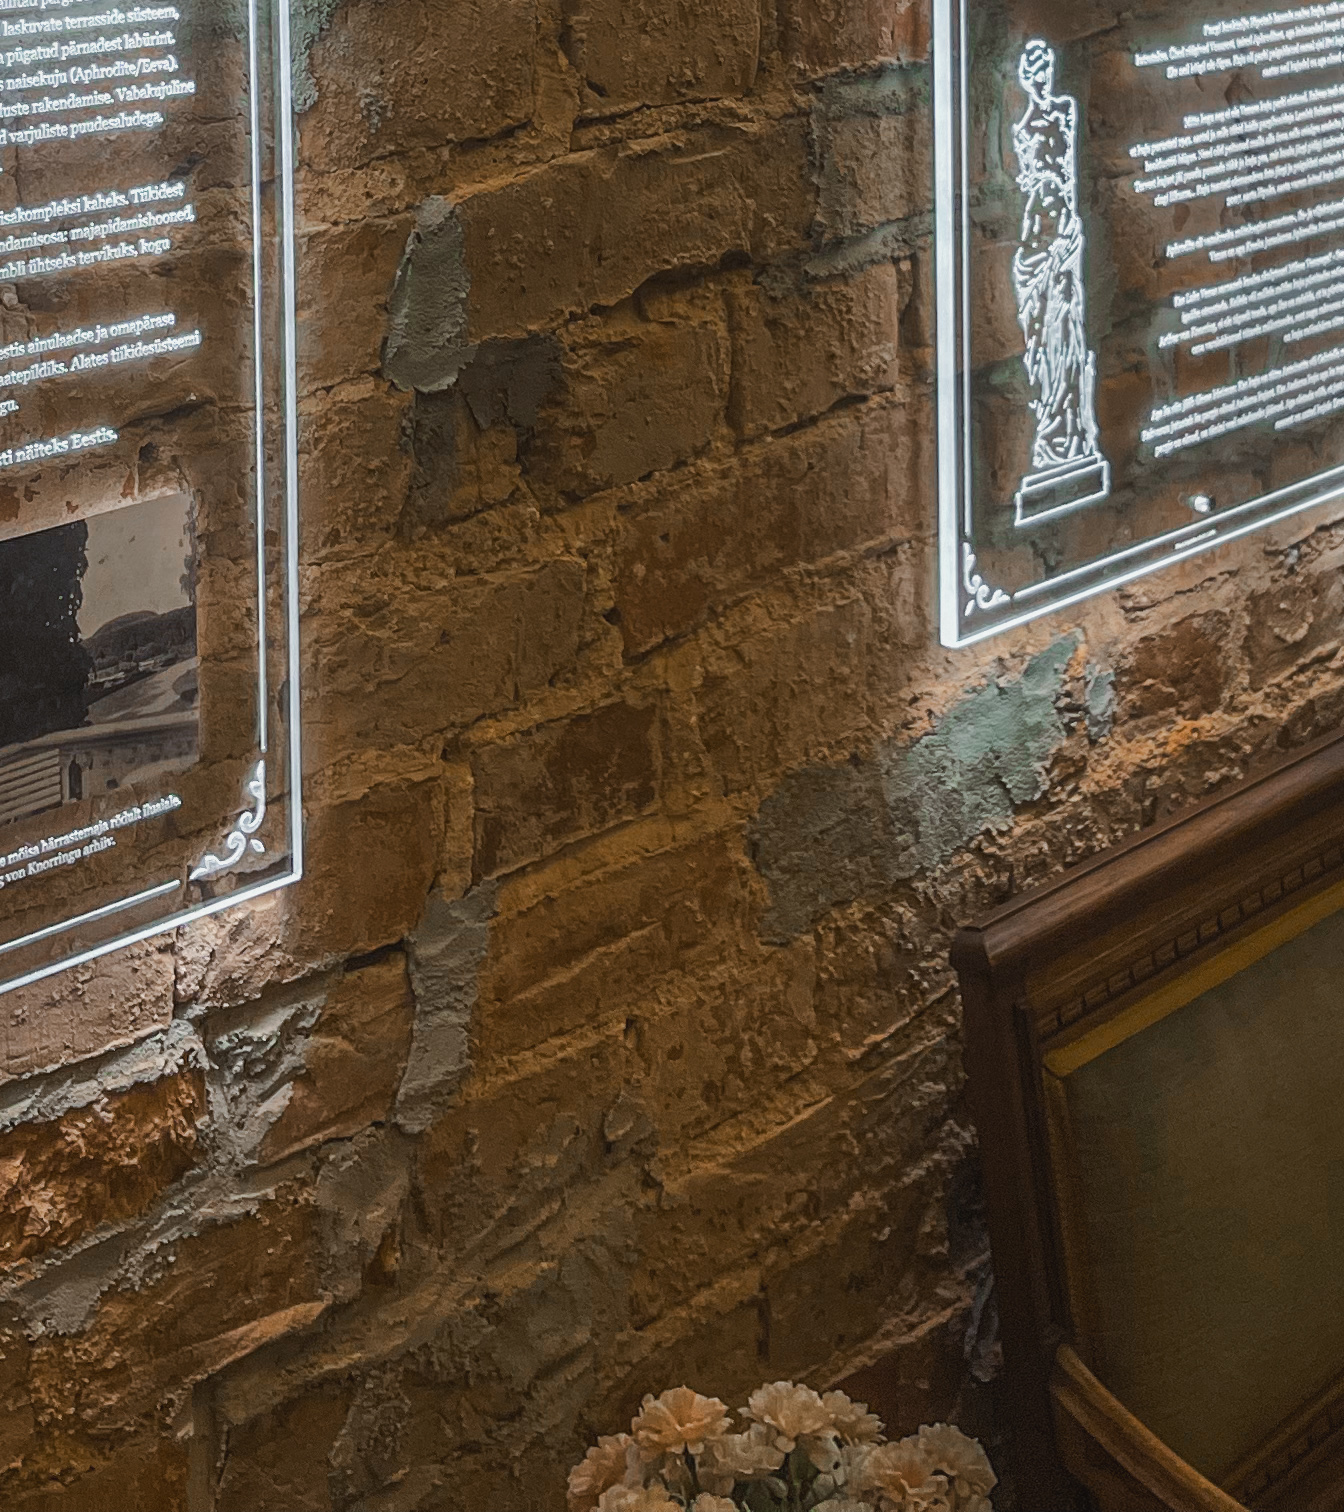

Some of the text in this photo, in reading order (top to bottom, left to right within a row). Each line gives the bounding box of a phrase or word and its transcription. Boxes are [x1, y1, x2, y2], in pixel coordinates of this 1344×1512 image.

[14, 438, 68, 462] näiteks
[70, 427, 117, 449] Eestis.
[7, 845, 39, 864] mõisa
[4, 868, 26, 881] von
